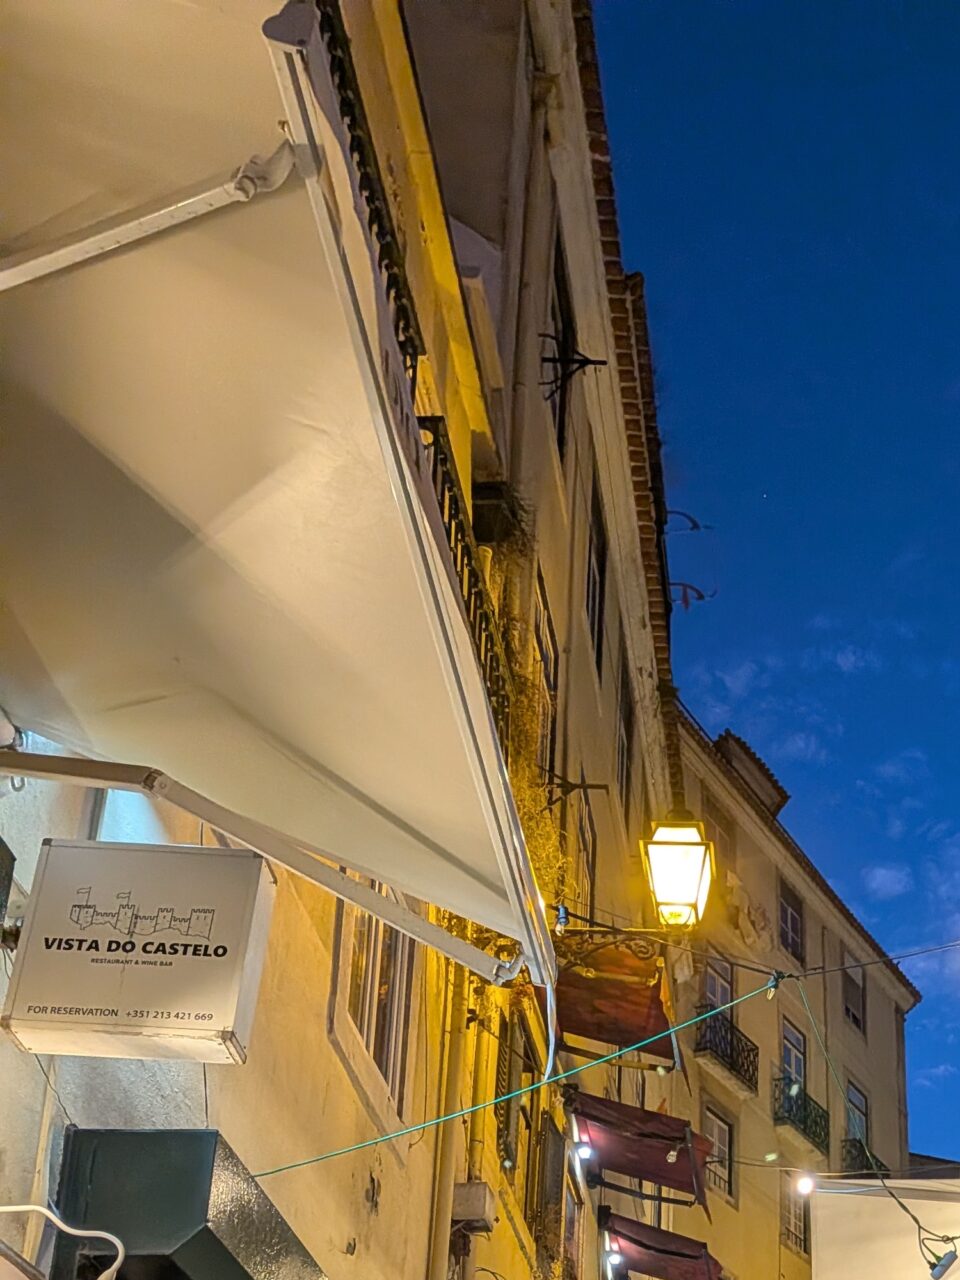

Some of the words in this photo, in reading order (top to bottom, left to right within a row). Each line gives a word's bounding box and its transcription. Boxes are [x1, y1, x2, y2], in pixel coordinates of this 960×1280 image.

[43, 937, 100, 952] VISTA
[106, 940, 137, 954] DO
[141, 941, 228, 957] CASTELO
[90, 957, 133, 965] RESTAURANT
[27, 1005, 48, 1014] FOR
[50, 1006, 119, 1017] RESERVATION
[125, 1010, 151, 1018] +351
[152, 1010, 171, 1019] 213
[174, 1011, 191, 1020] 421
[194, 1012, 214, 1021] 669
